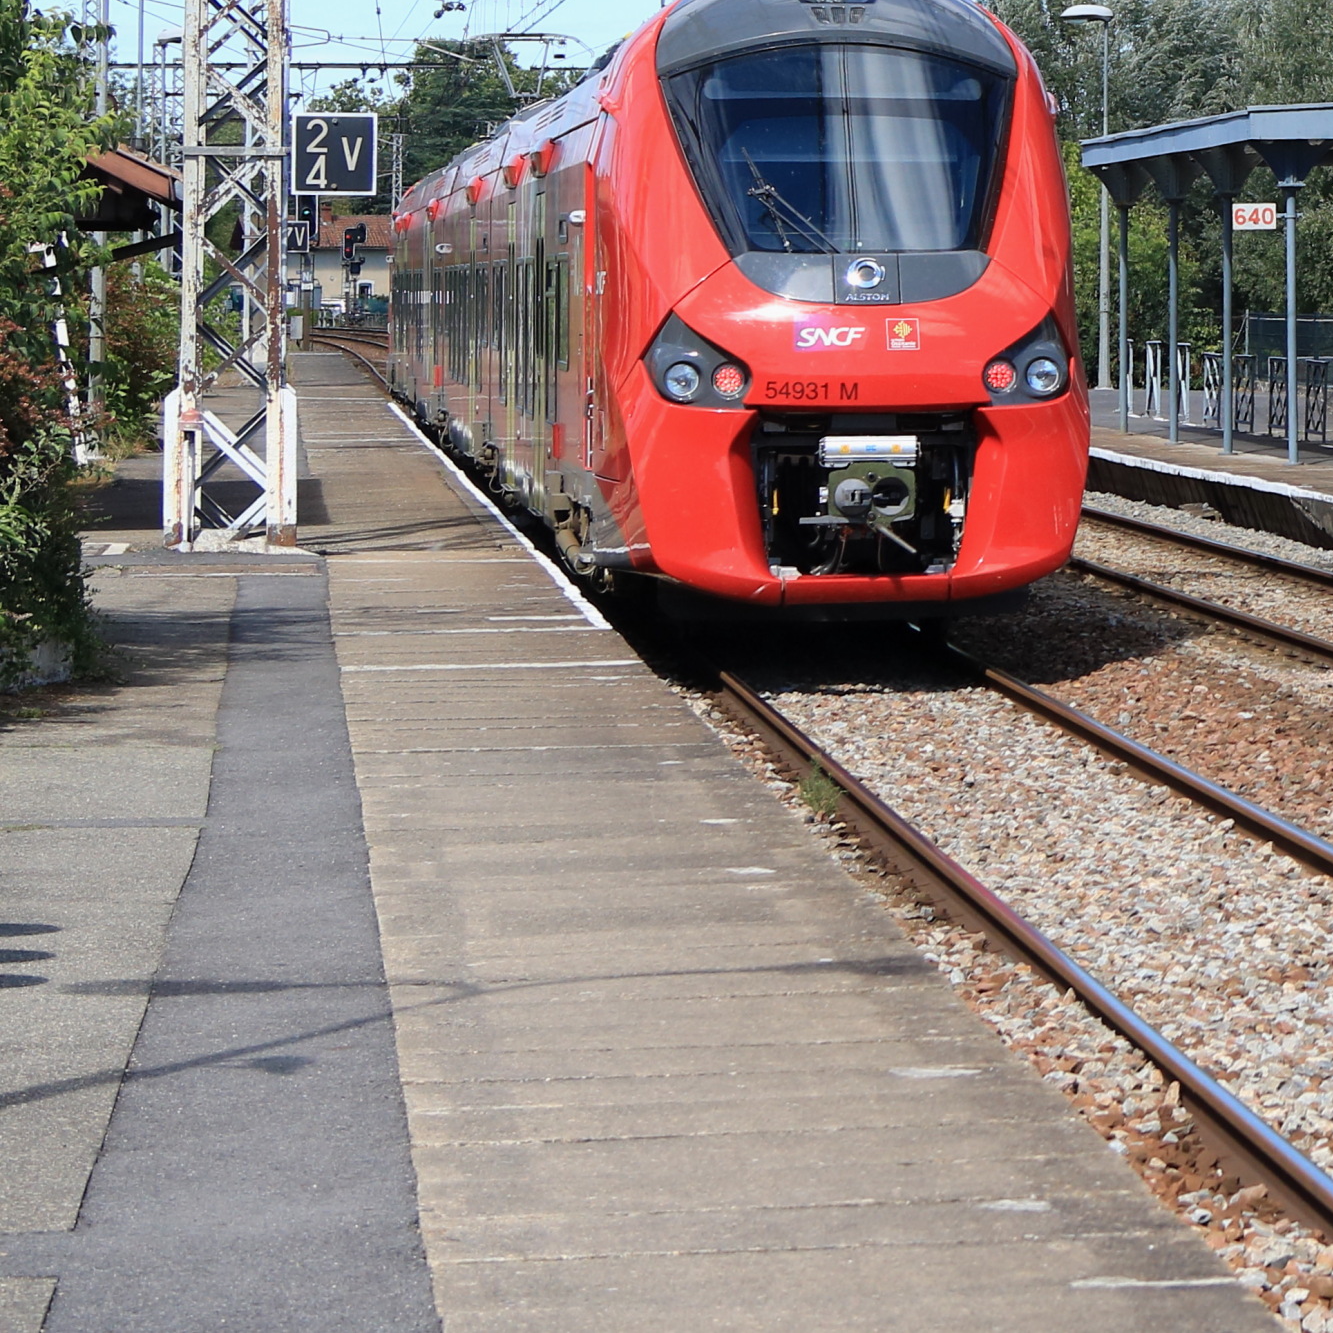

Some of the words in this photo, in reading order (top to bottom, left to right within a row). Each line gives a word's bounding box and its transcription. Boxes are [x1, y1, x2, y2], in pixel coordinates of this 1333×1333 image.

[306, 119, 328, 153] 2
[341, 137, 363, 171] V
[305, 155, 327, 188] 4
[1234, 207, 1274, 226] 640
[796, 327, 866, 348] SNCF
[765, 381, 829, 400] 54931
[840, 382, 859, 400] M
